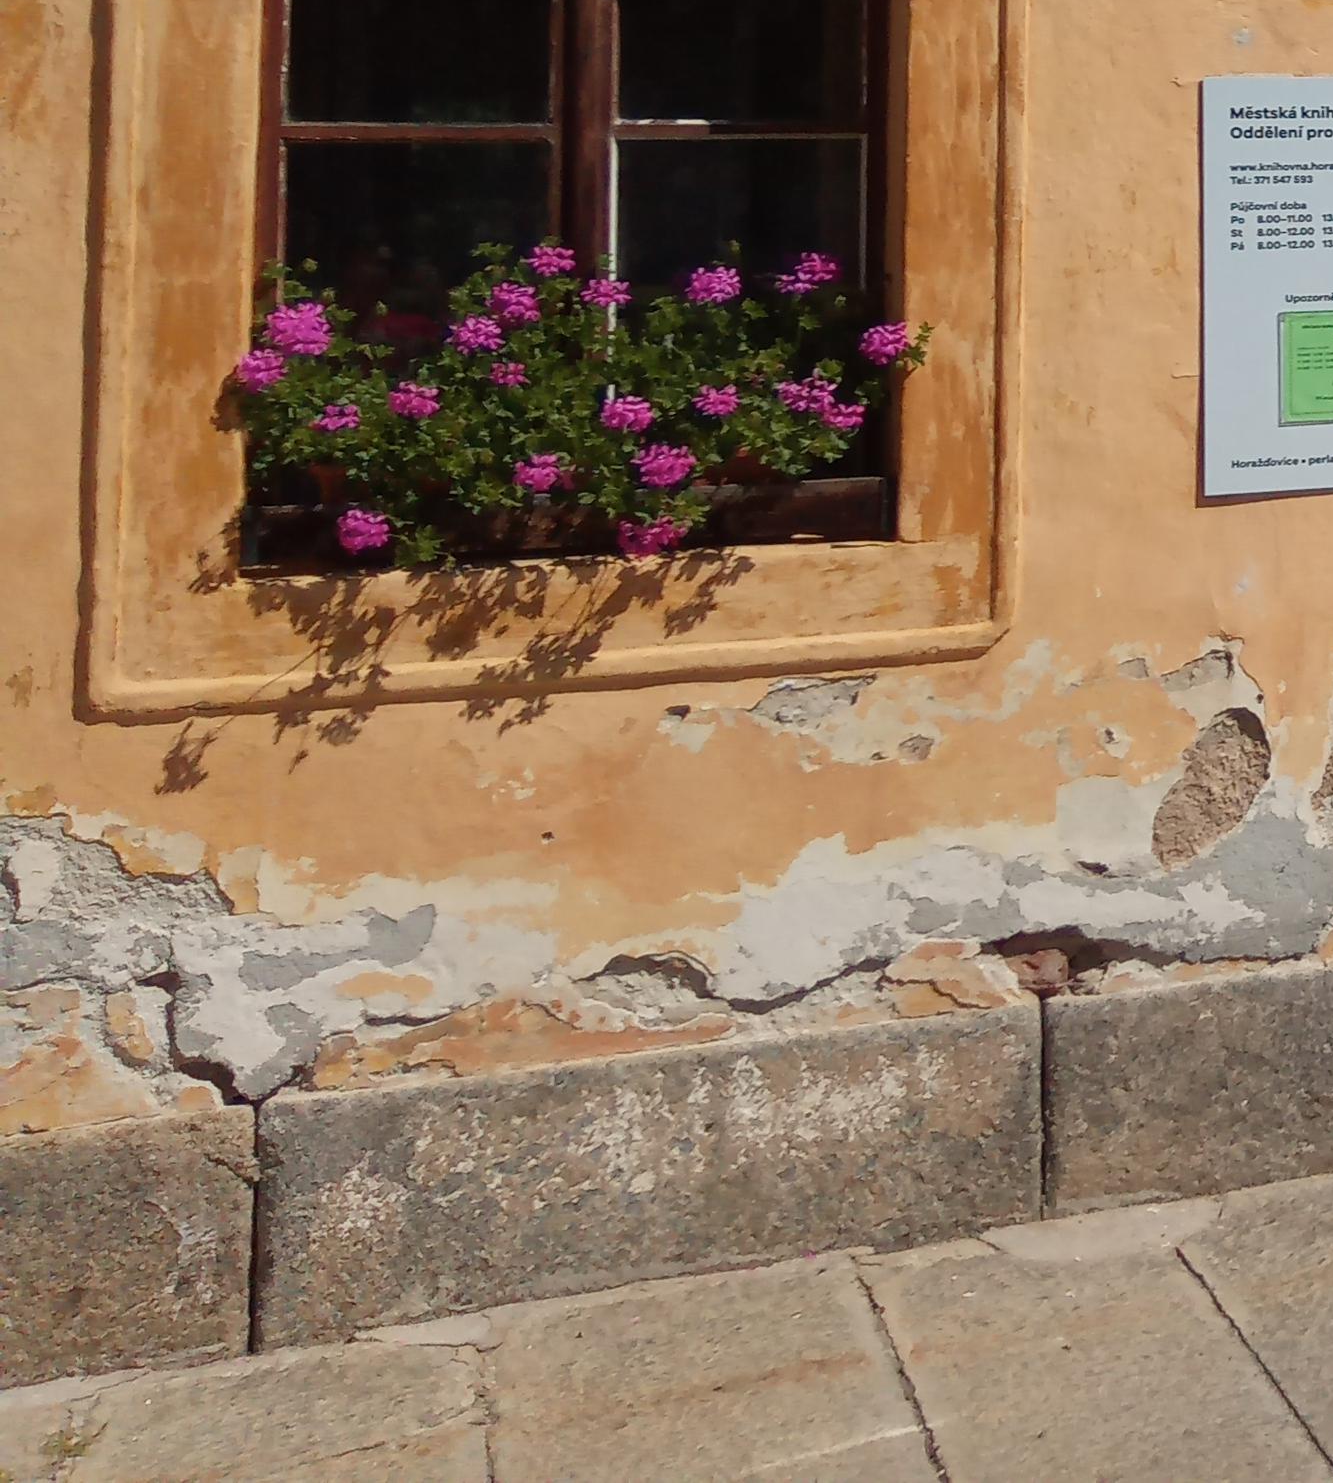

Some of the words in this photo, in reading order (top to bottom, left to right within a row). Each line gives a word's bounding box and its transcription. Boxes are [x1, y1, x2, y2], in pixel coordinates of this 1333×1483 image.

[1230, 106, 1297, 119] Městská
[1230, 126, 1303, 139] Oddělení
[1307, 129, 1333, 140] pro
[1254, 176, 1271, 184] 371
[1273, 175, 1291, 184] 547
[1294, 175, 1313, 184] 593
[1230, 201, 1278, 212] Půjčovní
[1280, 201, 1307, 210] doba
[1230, 216, 1245, 224] Po
[1230, 229, 1243, 237] St
[1230, 241, 1245, 251] Pá
[1231, 457, 1299, 469] Horažďovice
